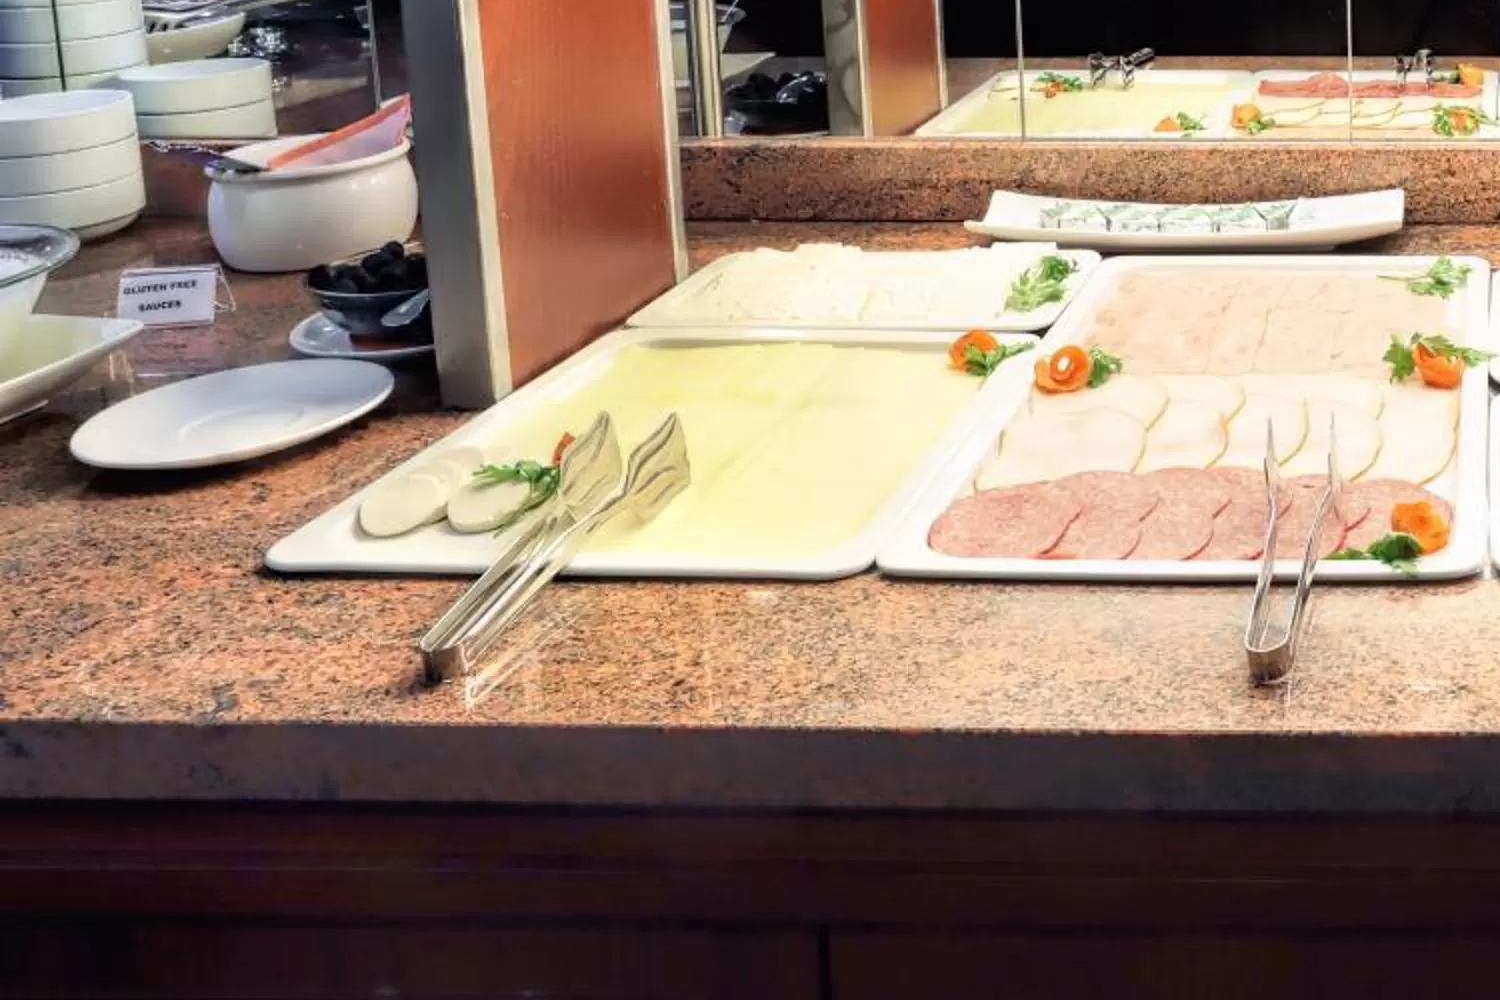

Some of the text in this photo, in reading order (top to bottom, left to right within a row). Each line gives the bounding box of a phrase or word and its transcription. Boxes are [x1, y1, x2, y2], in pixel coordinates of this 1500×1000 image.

[123, 279, 198, 296] GLUTEN FREE
[138, 299, 182, 312] SAUCES
